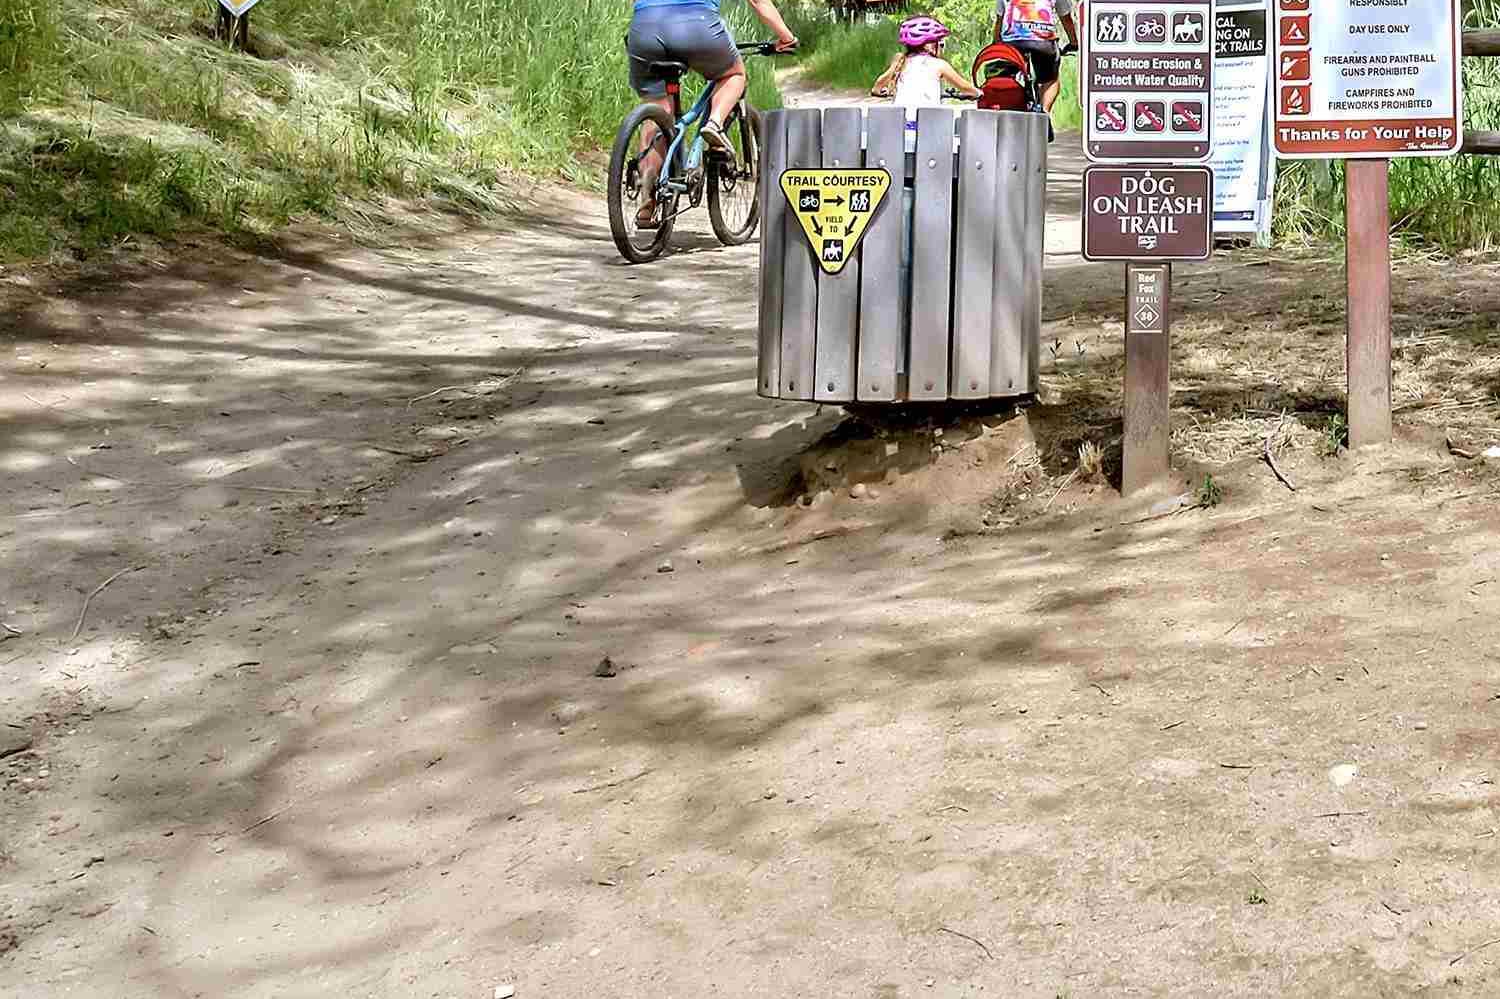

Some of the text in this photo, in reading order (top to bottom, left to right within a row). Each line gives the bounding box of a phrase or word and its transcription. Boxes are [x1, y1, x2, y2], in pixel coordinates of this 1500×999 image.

[1216, 17, 1235, 28] CAL
[1216, 28, 1250, 40] NG ON
[1350, 25, 1410, 34] DAY USE ONLY
[1229, 40, 1263, 51] TRAILS
[1096, 58, 1109, 69] To
[1111, 58, 1149, 69] Reduce
[1152, 58, 1191, 69] Erosion
[1194, 58, 1202, 69] &
[1324, 54, 1436, 64] FIREARMS AND PAINTBALL
[1341, 67, 1419, 76] GUNS PROHIBITED
[1094, 75, 1132, 86] Protect
[1134, 75, 1166, 86] Water
[1168, 74, 1204, 88] Quality
[1346, 88, 1415, 98] CAMPFIRES AND
[1328, 100, 1433, 110] FIREWORKS PROHIBITED
[1279, 125, 1453, 141] Thanks for Your Help
[786, 176, 884, 186] TRAIL COURTESY
[1121, 177, 1175, 194] DOG
[1093, 197, 1129, 214] ON
[1136, 197, 1203, 214] LEASH
[1118, 217, 1178, 234] TRAIL
[1138, 273, 1156, 283] Red
[1138, 284, 1154, 293] Fox
